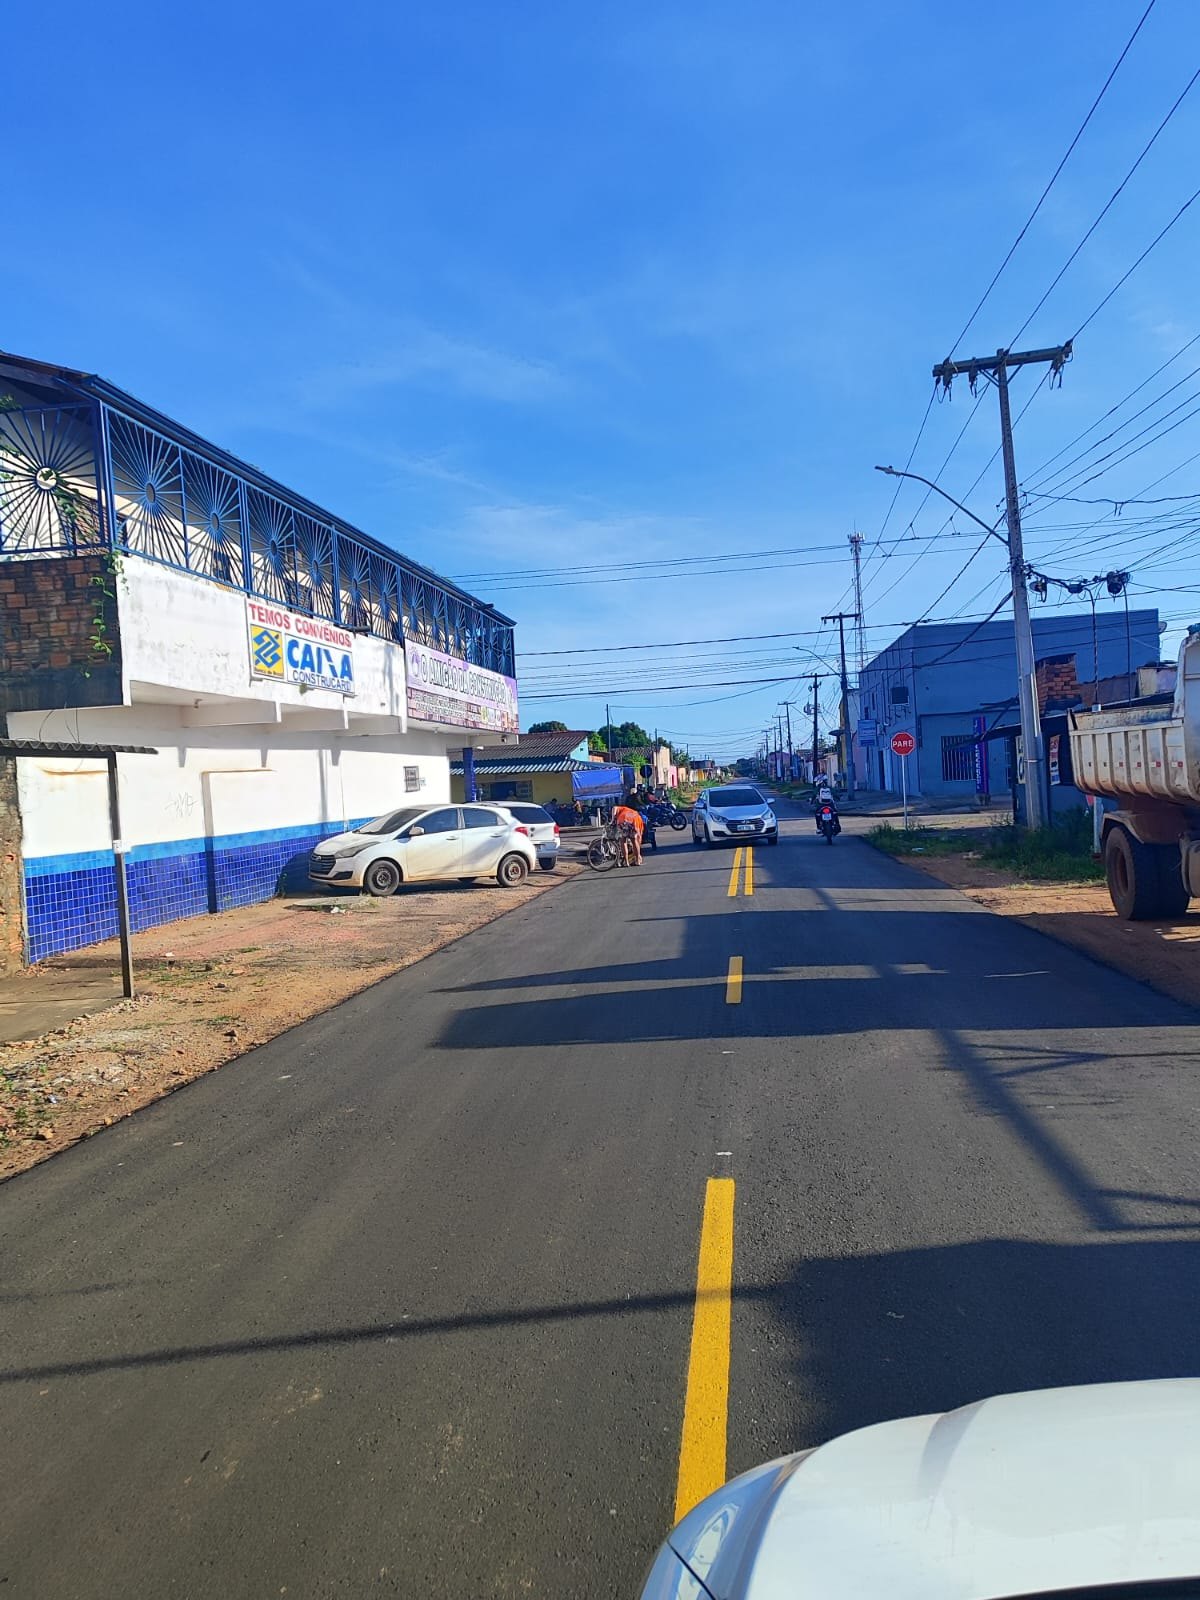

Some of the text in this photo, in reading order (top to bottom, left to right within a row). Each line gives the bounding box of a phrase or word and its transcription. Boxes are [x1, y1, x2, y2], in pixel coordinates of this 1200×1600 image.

[248, 603, 291, 630] TEMOS
[292, 670, 352, 691] CONSTRUCARD
[421, 654, 428, 683] O
[429, 658, 457, 691] AMIGÃO
[458, 666, 469, 695] DA
[892, 739, 913, 748] PARE
